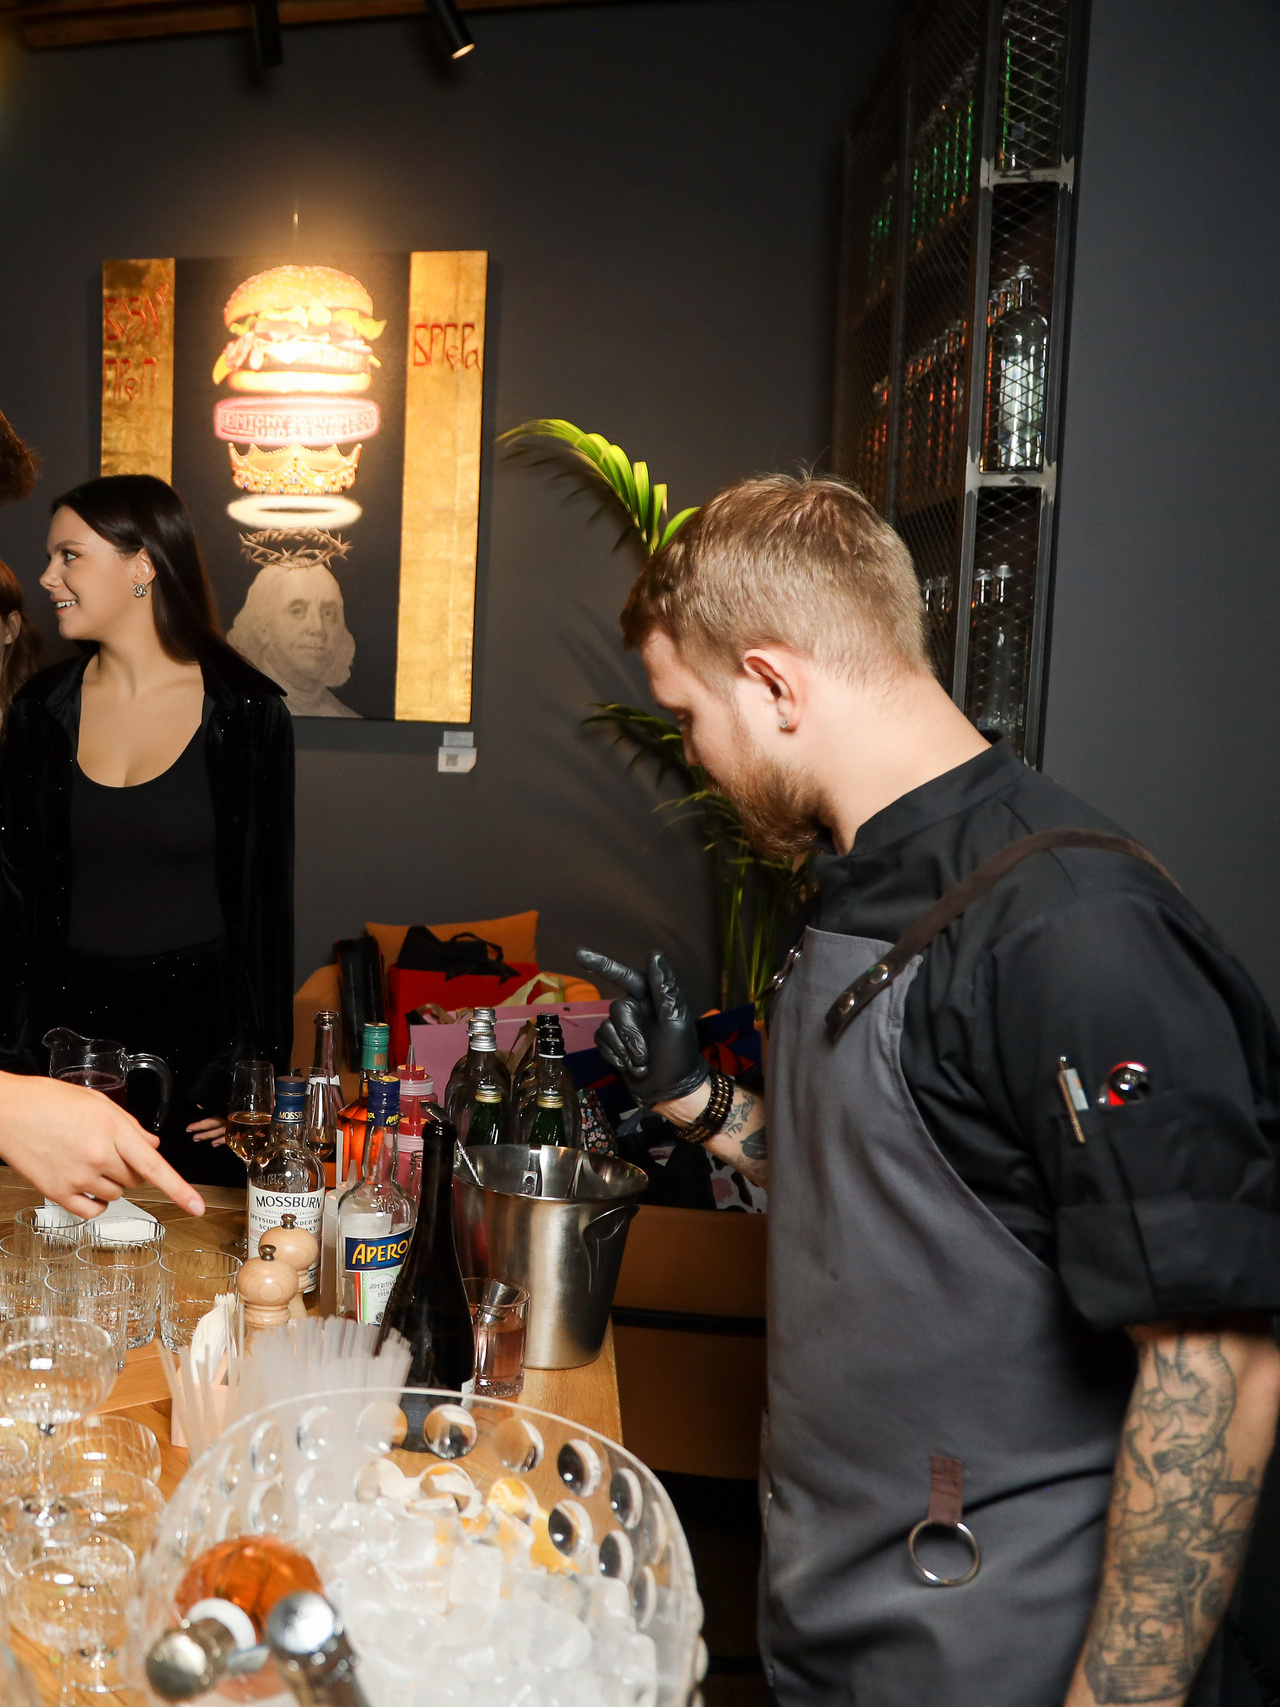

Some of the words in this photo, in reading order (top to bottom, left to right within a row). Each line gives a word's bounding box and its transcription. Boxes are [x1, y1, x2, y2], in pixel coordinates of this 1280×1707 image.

[278, 1111, 304, 1120] MOSSB
[255, 1195, 322, 1209] MOSSBURN
[352, 1239, 412, 1265] APERO
